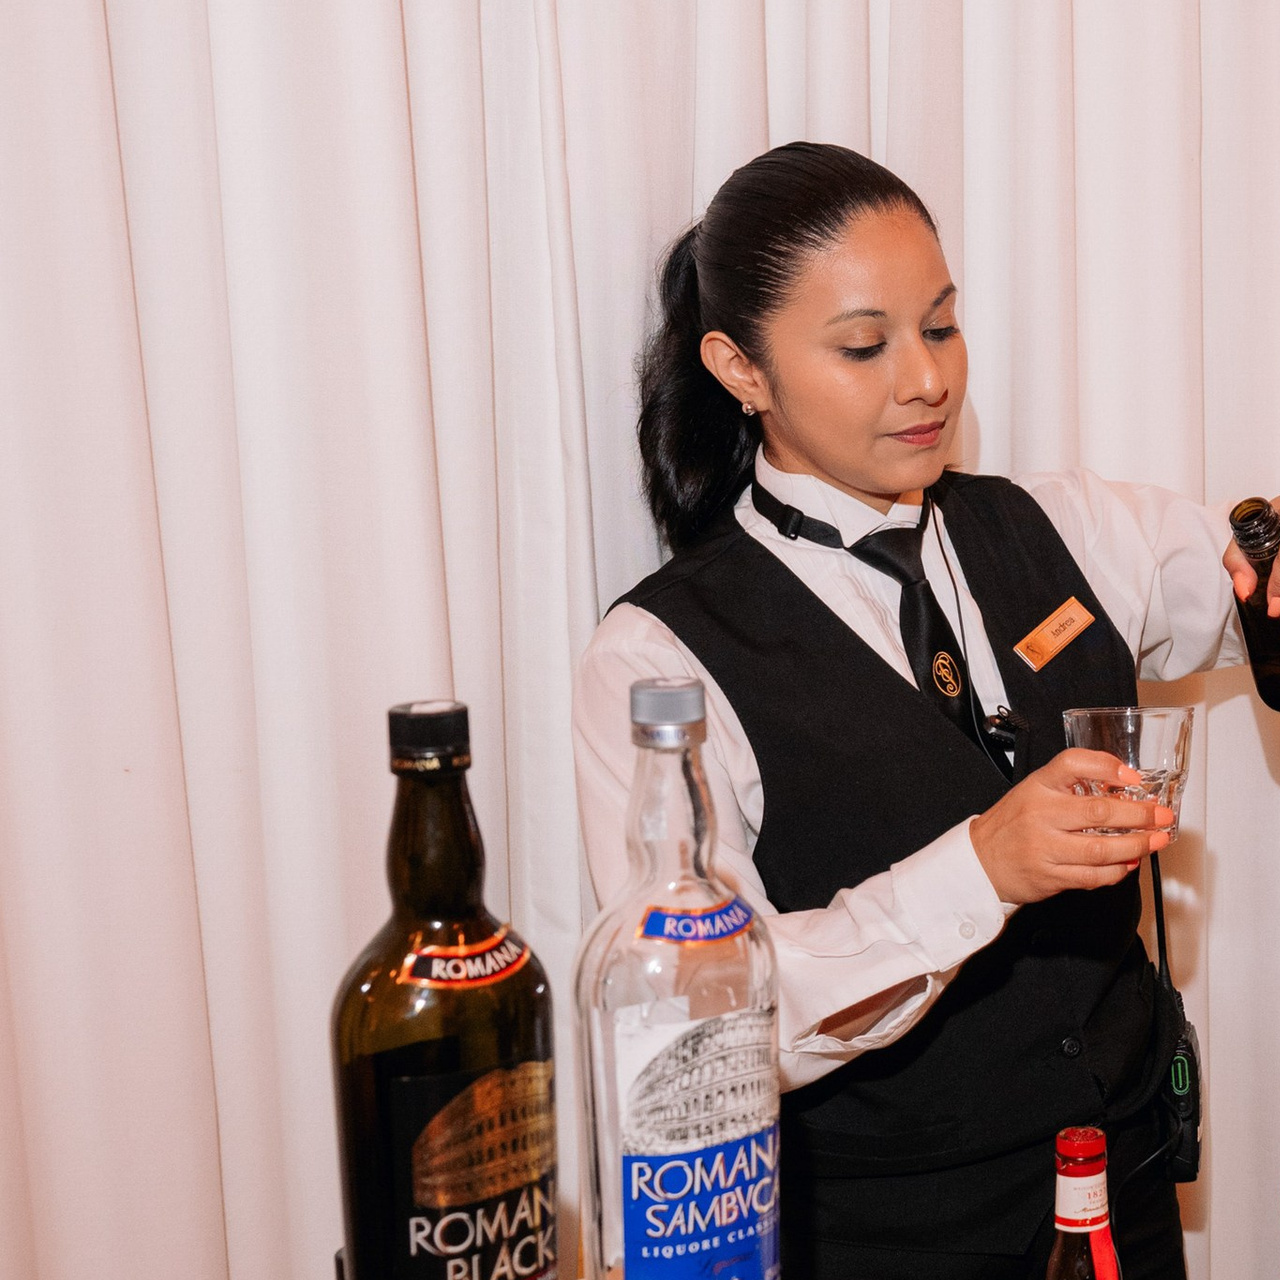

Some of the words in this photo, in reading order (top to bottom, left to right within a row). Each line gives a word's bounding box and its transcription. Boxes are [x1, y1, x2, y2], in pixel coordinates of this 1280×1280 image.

[1051, 616, 1075, 639] Andrea
[663, 904, 749, 938] ROMANA
[430, 939, 523, 980] ROMANA
[645, 1176, 779, 1238] SAMBVC
[641, 1236, 721, 1259] LIQUORE
